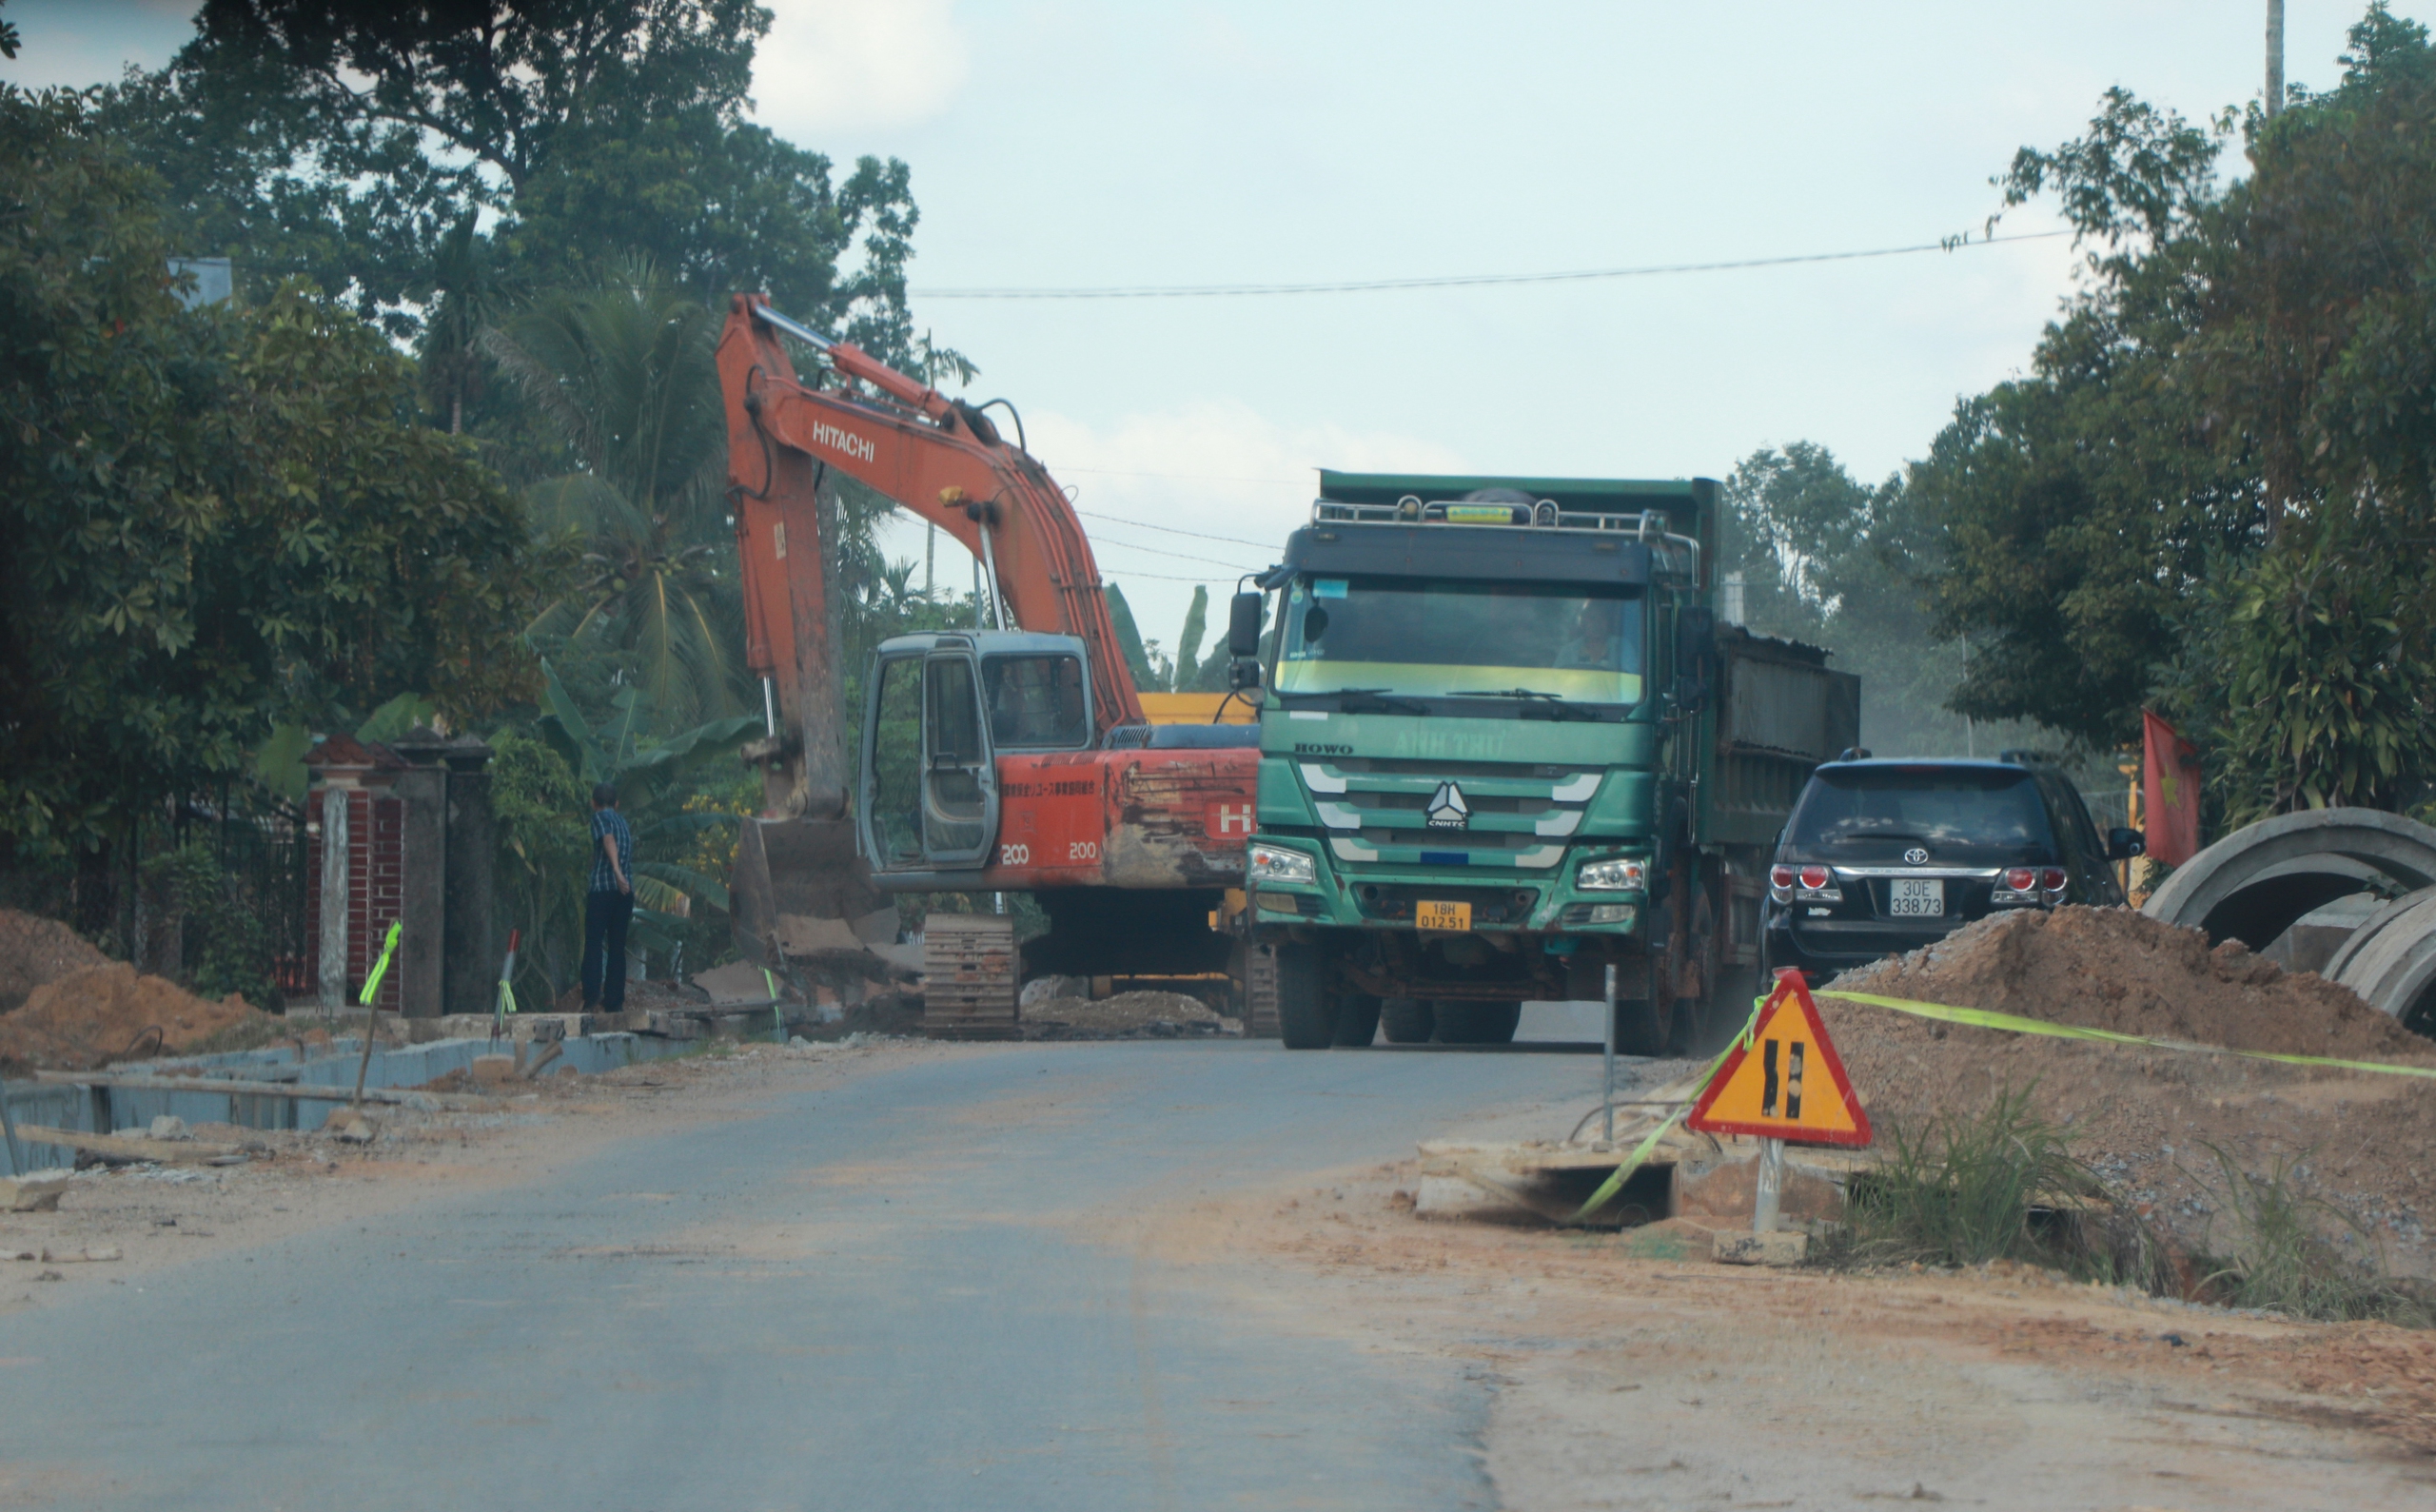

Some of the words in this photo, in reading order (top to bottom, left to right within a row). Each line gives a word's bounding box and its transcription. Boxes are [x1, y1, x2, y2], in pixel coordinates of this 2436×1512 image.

[813, 420, 874, 463] HITACHI
[1294, 743, 1354, 755] HOWO
[1070, 841, 1096, 859] 200
[1903, 880, 1931, 896] 30E
[1434, 903, 1456, 915] 18H
[1893, 897, 1941, 914] 338.73
[1421, 915, 1464, 929] 012.51
